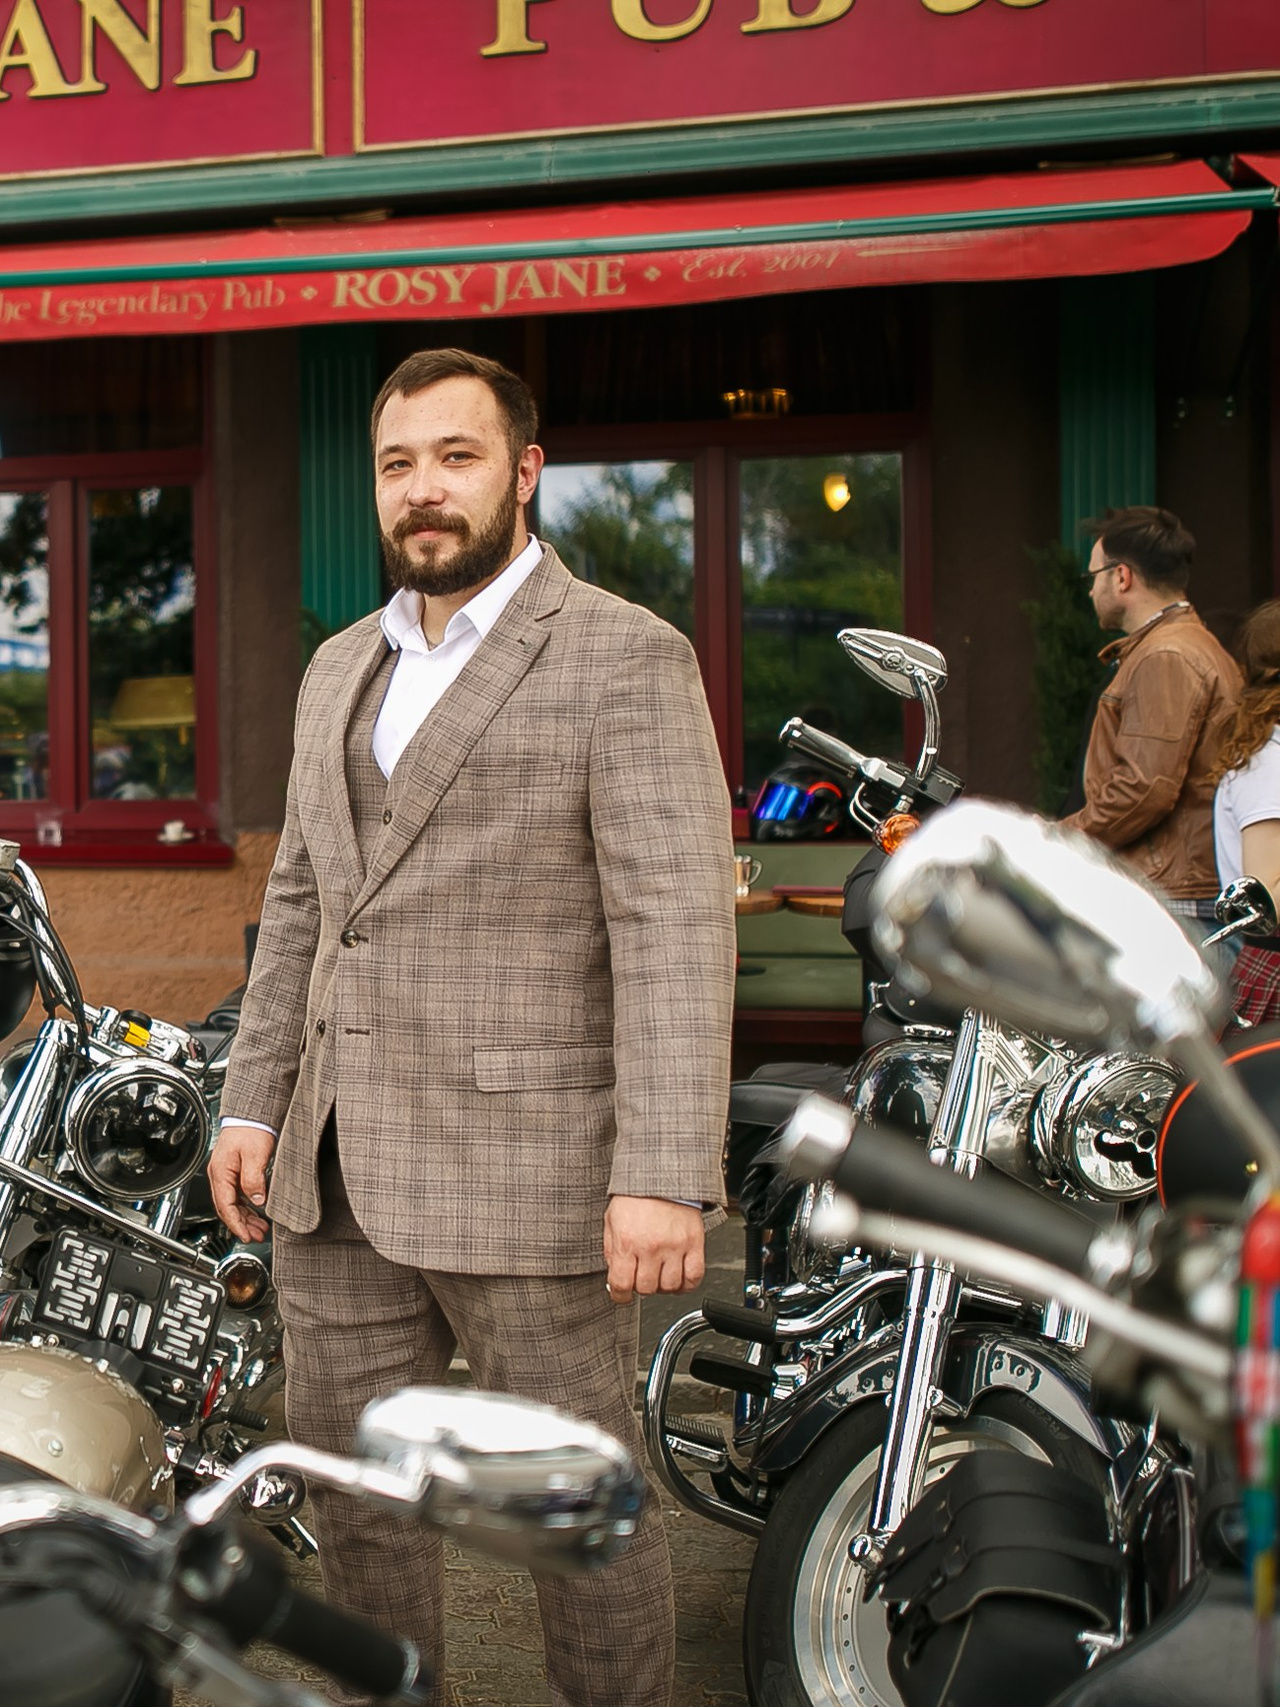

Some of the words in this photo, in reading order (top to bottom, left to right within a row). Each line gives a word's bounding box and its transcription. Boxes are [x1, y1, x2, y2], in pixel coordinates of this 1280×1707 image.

[39, 281, 215, 325] Legendary
[223, 279, 286, 311] Pub
[332, 266, 476, 308] ROSY
[479, 258, 626, 314] JANE
